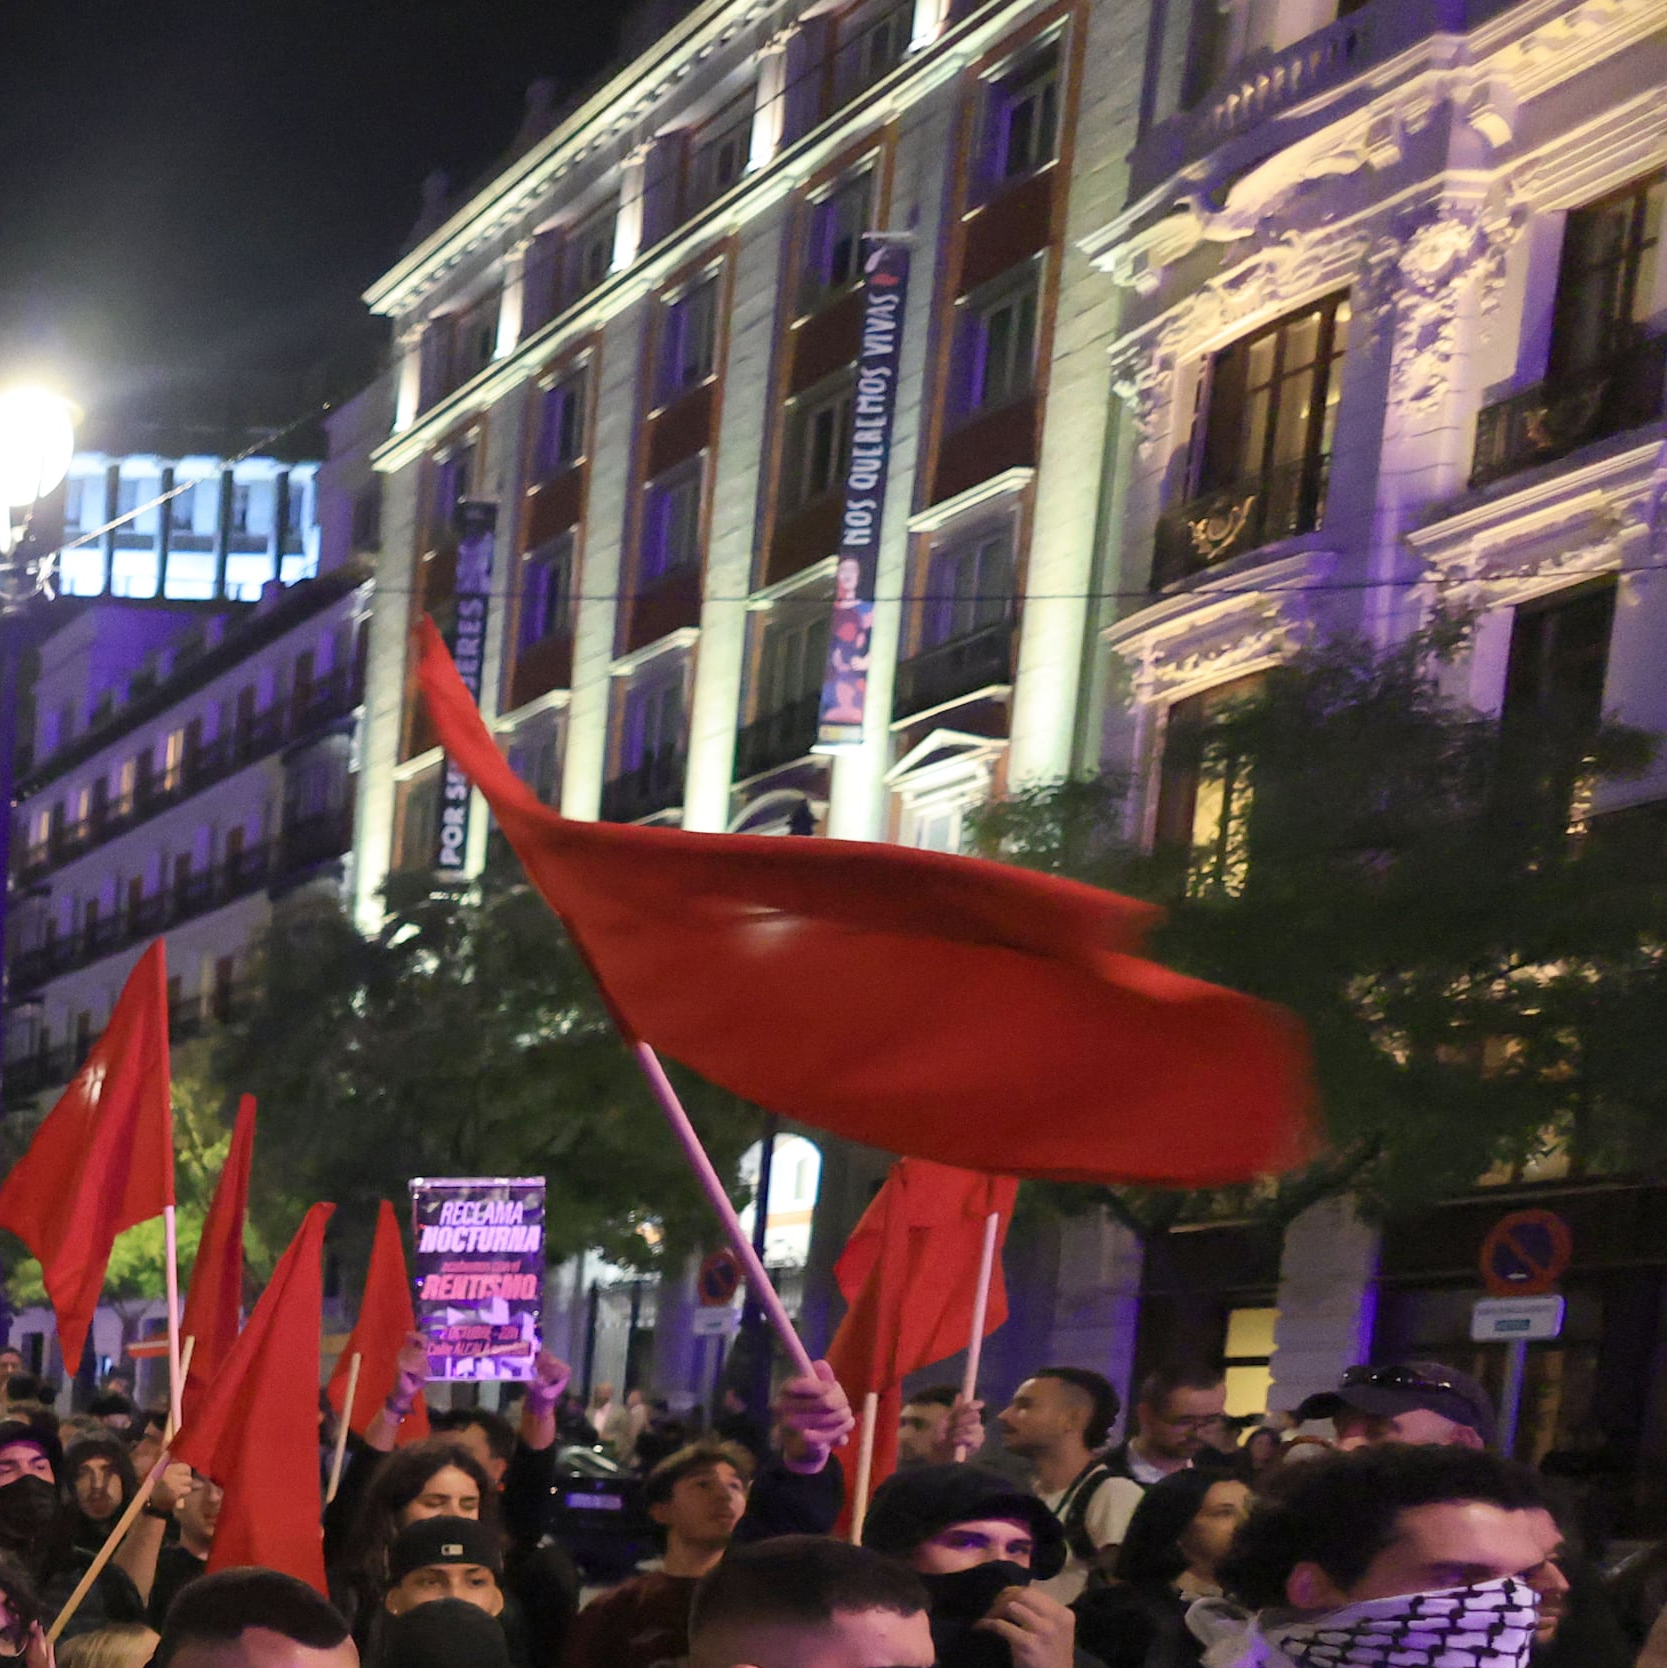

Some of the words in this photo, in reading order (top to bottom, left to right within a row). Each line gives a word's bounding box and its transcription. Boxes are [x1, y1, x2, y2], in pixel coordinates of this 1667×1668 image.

[862, 293, 899, 357] VIVAS
[848, 366, 892, 491] QUEREMOS
[843, 499, 876, 547] NOS
[440, 806, 465, 865] POR
[439, 1201, 524, 1226] RECLAMA
[419, 1225, 542, 1253] NOCTURNA
[420, 1273, 538, 1300] RENTISMO
